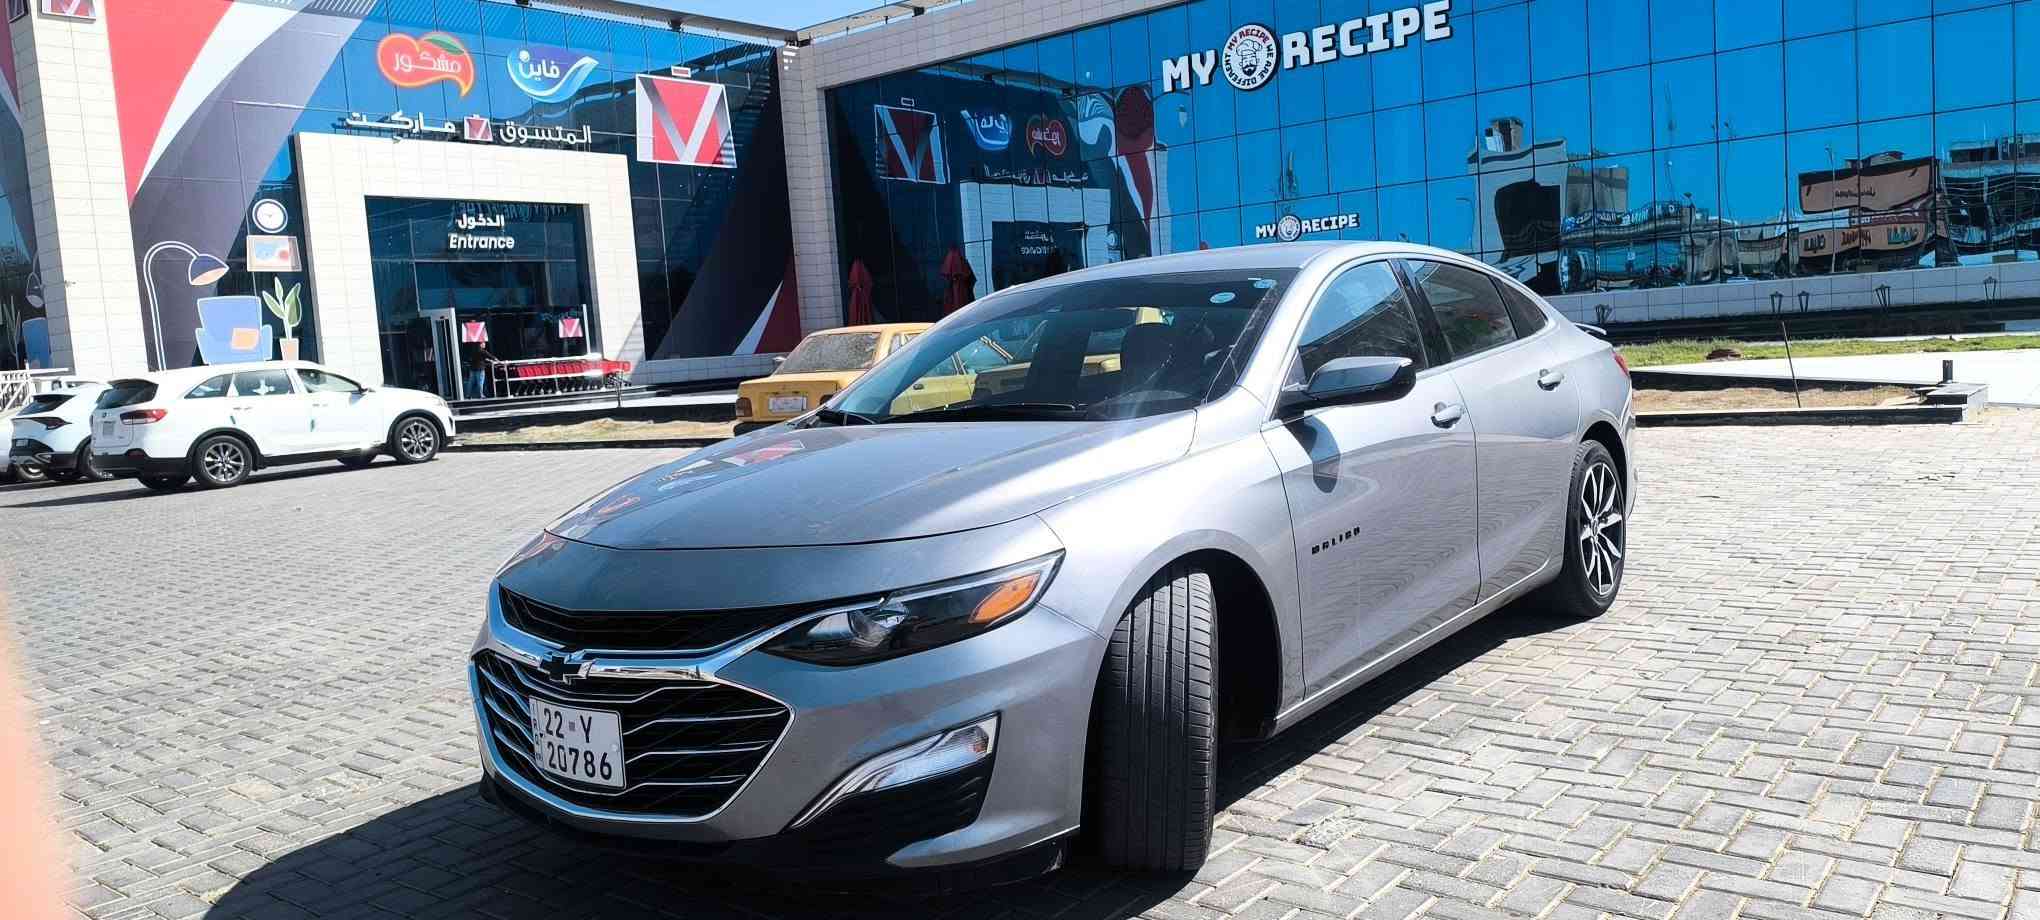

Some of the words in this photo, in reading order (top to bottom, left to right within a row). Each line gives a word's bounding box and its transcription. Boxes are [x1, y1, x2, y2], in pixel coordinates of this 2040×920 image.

[1162, 50, 1216, 92] MY
[1282, 0, 1451, 69] RECIPE
[1228, 36, 1238, 51] MY
[1239, 28, 1269, 43] RECIPE
[1266, 43, 1274, 58] WE
[393, 50, 462, 75] مشكور
[518, 50, 560, 80] فاين
[1224, 53, 1257, 86] DIFFERENT
[1258, 60, 1272, 79] ARE
[346, 110, 456, 133] ماركت
[499, 118, 592, 145] المتسوق
[455, 213, 505, 229] الدخول
[1255, 224, 1276, 238] MY
[1302, 214, 1358, 233] RECIPE
[449, 233, 515, 249] Entrance
[543, 707, 565, 739] 22
[579, 714, 593, 744] Y
[546, 741, 613, 781] 20786
